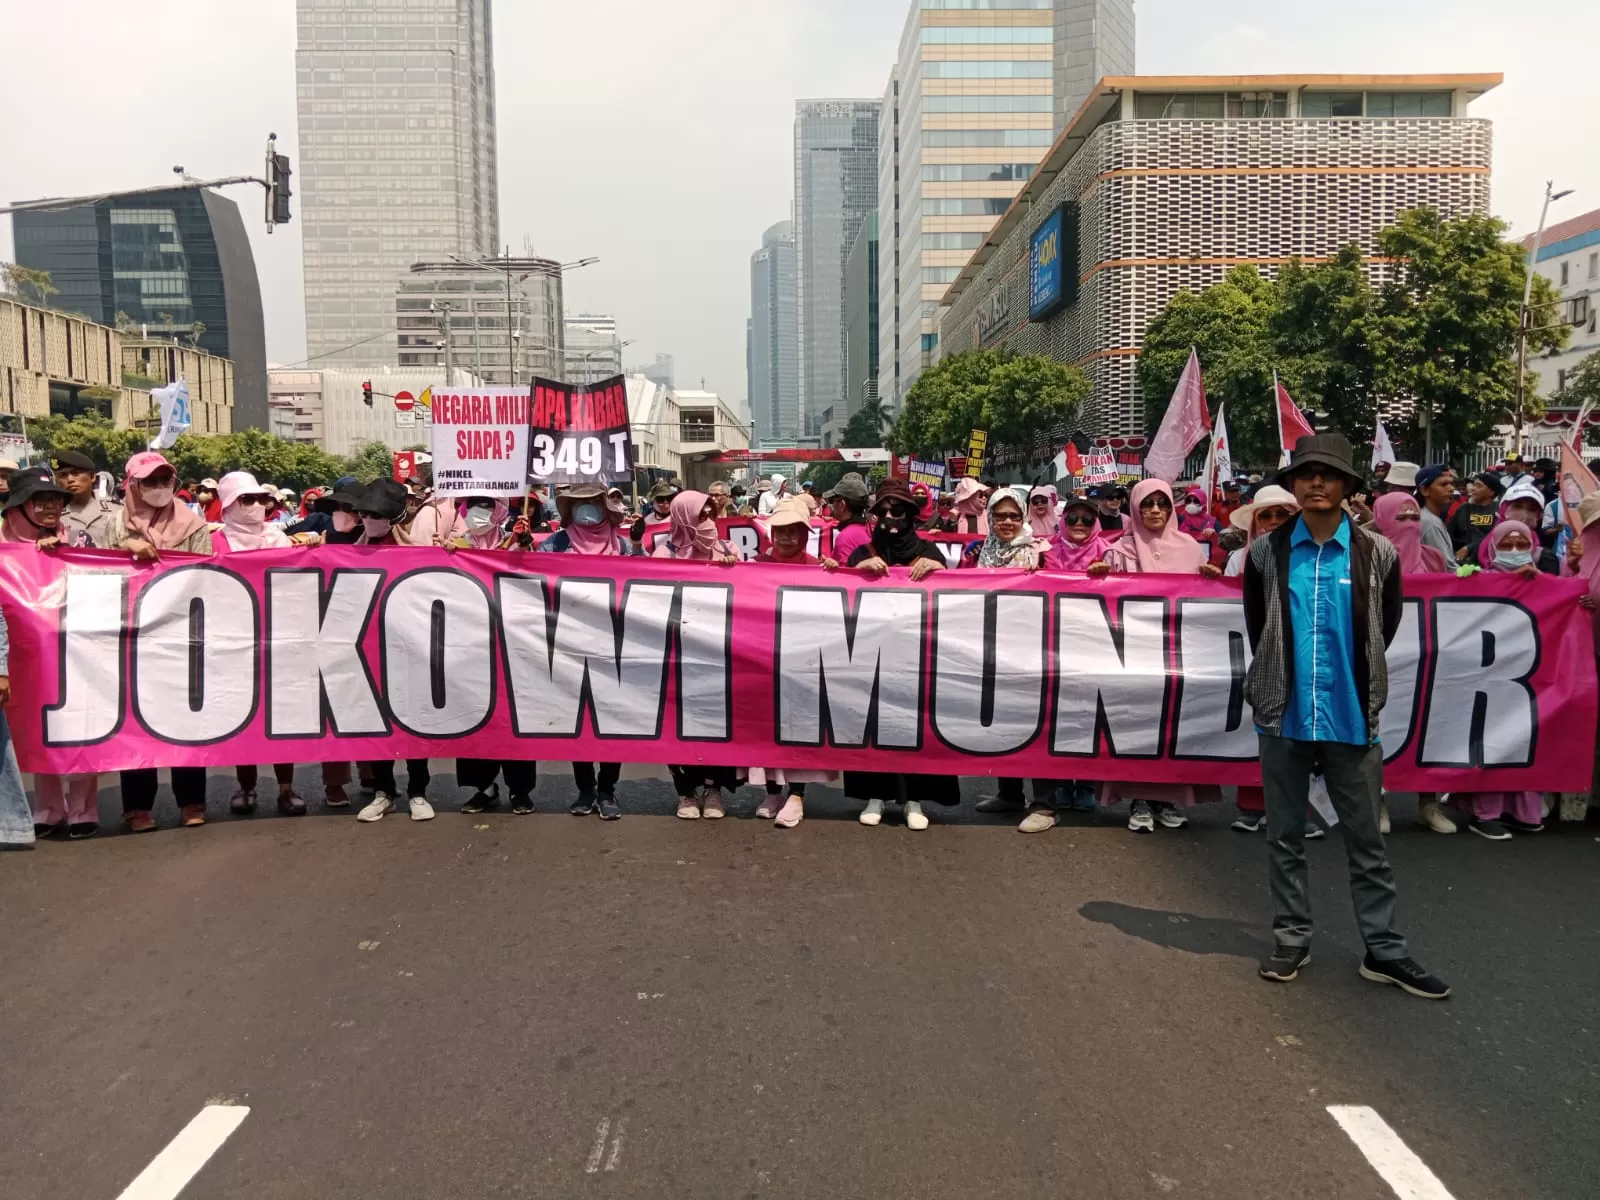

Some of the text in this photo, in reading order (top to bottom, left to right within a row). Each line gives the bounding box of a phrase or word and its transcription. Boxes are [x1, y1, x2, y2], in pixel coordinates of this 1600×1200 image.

[432, 395, 493, 424] NEGARA
[532, 384, 627, 432] APA KABAR
[456, 430, 502, 460] SIAPA
[533, 431, 627, 476] 349 T
[438, 470, 473, 479] #NIKEL
[43, 567, 733, 746] JOKOWI
